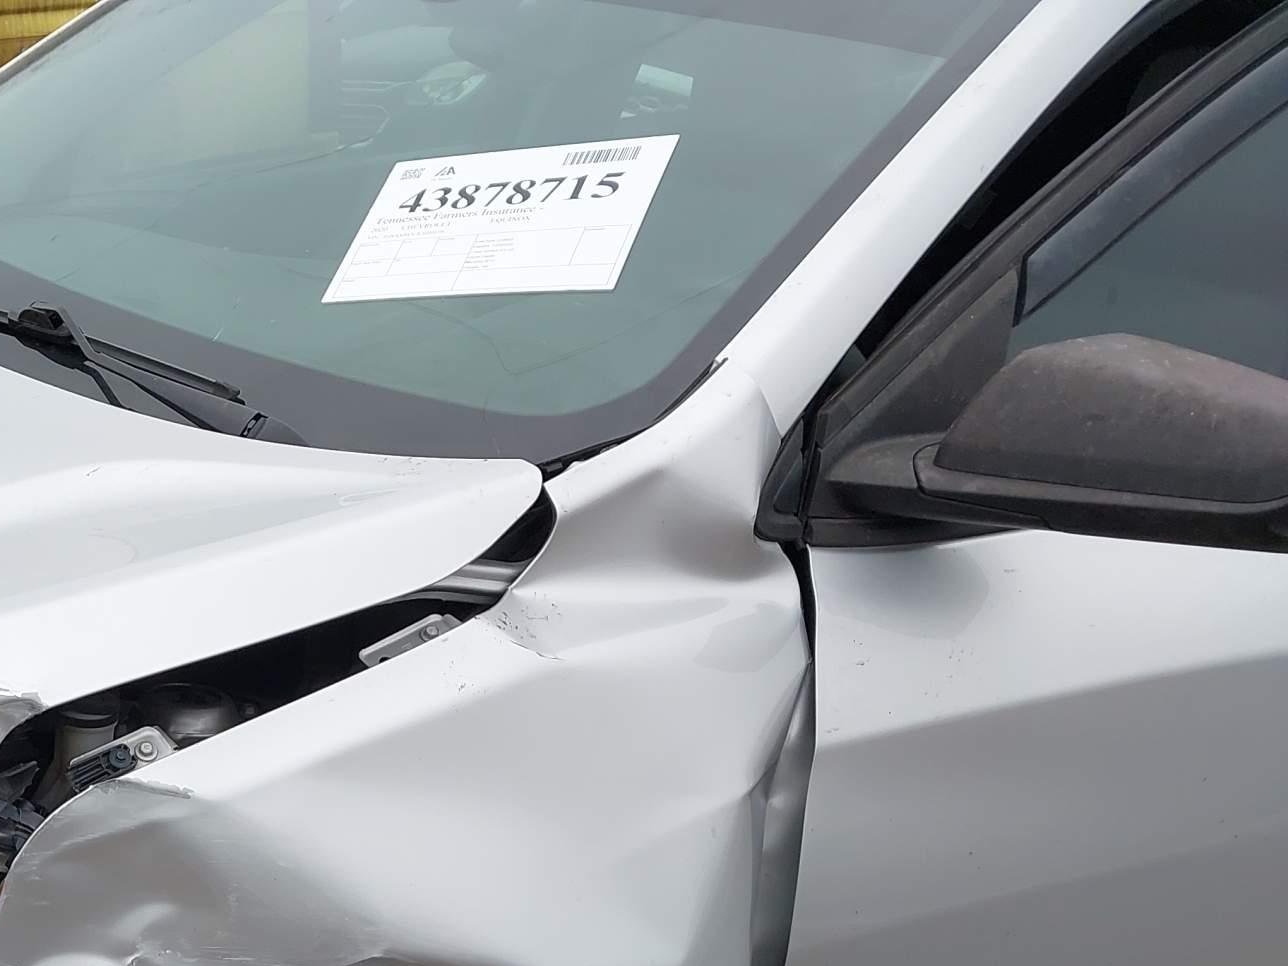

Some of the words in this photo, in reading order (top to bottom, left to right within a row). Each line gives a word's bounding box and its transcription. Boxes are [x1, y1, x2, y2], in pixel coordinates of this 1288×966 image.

[399, 171, 627, 213] 43878715
[377, 213, 432, 225] Tennessee
[433, 210, 478, 220] Farmers
[481, 206, 536, 216] Insurance
